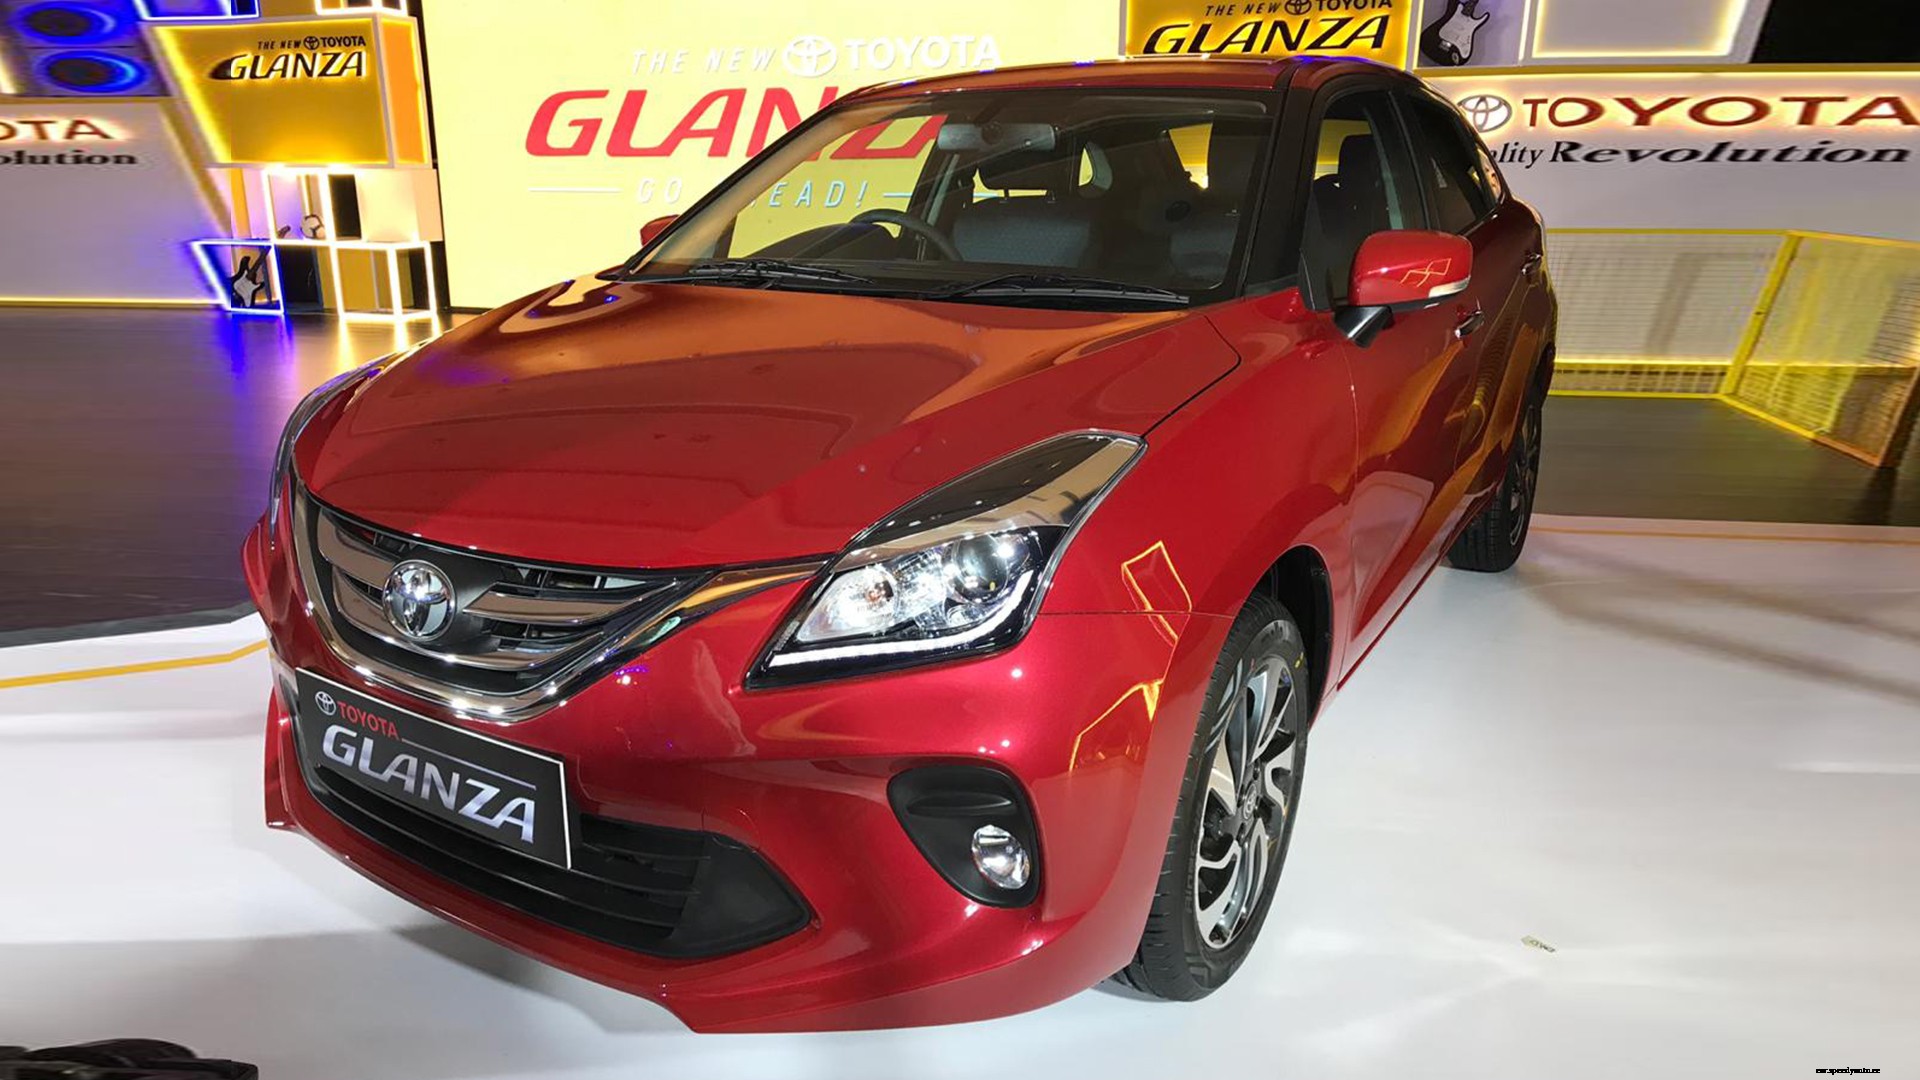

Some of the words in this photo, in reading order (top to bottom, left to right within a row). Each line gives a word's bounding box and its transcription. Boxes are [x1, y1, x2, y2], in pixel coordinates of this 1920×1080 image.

[1205, 5, 1234, 16] THE
[1243, 1, 1279, 14] NEW
[258, 40, 275, 49] THE
[279, 38, 301, 49] NEW
[320, 36, 366, 48] TOYOTA
[1143, 15, 1389, 54] GLANZA
[209, 51, 367, 81] GLANZA
[633, 48, 689, 75] THE
[705, 47, 776, 73] NEW
[844, 35, 1001, 70] TOYOTA
[1523, 97, 1920, 127] TOYOTA
[1549, 140, 1912, 163] Revolution
[636, 178, 683, 204] GO
[337, 702, 400, 742] TOYOTA
[323, 725, 535, 843] GLANZA
